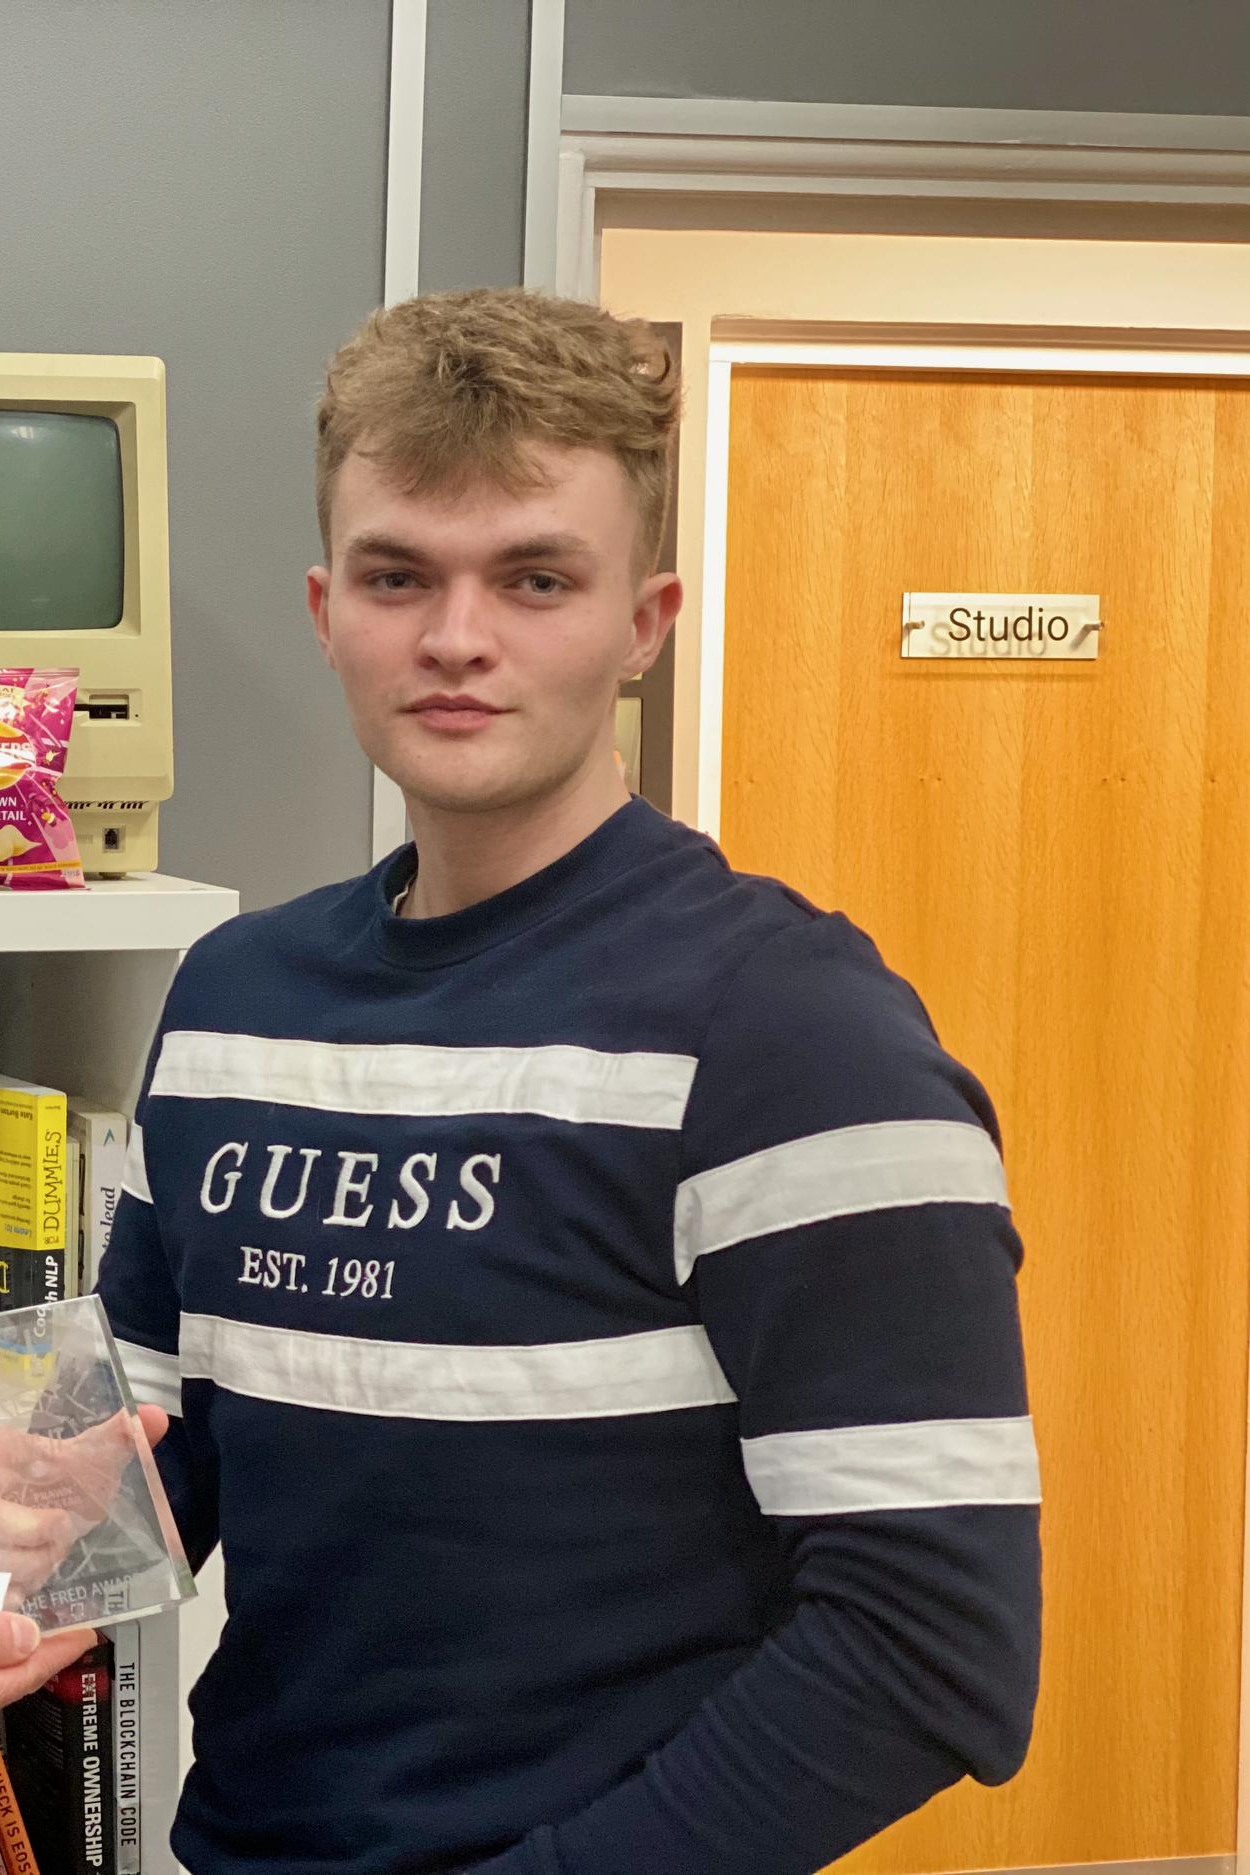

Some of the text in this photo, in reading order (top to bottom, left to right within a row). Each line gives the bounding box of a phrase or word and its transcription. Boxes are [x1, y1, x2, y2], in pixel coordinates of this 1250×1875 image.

[948, 606, 1069, 641] Studio
[0, 1107, 33, 1121] Kate Burton
[42, 1131, 63, 1232] DUMMIES
[200, 1141, 501, 1231] GUESS
[99, 1186, 115, 1227] lead
[14, 1226, 33, 1239] Learn
[44, 1235, 60, 1245] FOR
[45, 1255, 58, 1288] NLP
[238, 1246, 395, 1299] EST. 1981
[20, 1594, 49, 1614] THE
[50, 1585, 88, 1607] FRED
[81, 1673, 103, 1867] EXTREME OWNERSHIP
[119, 1662, 138, 1847] THE BLOCKCHAIN CODE
[4, 1821, 20, 1838] IS
